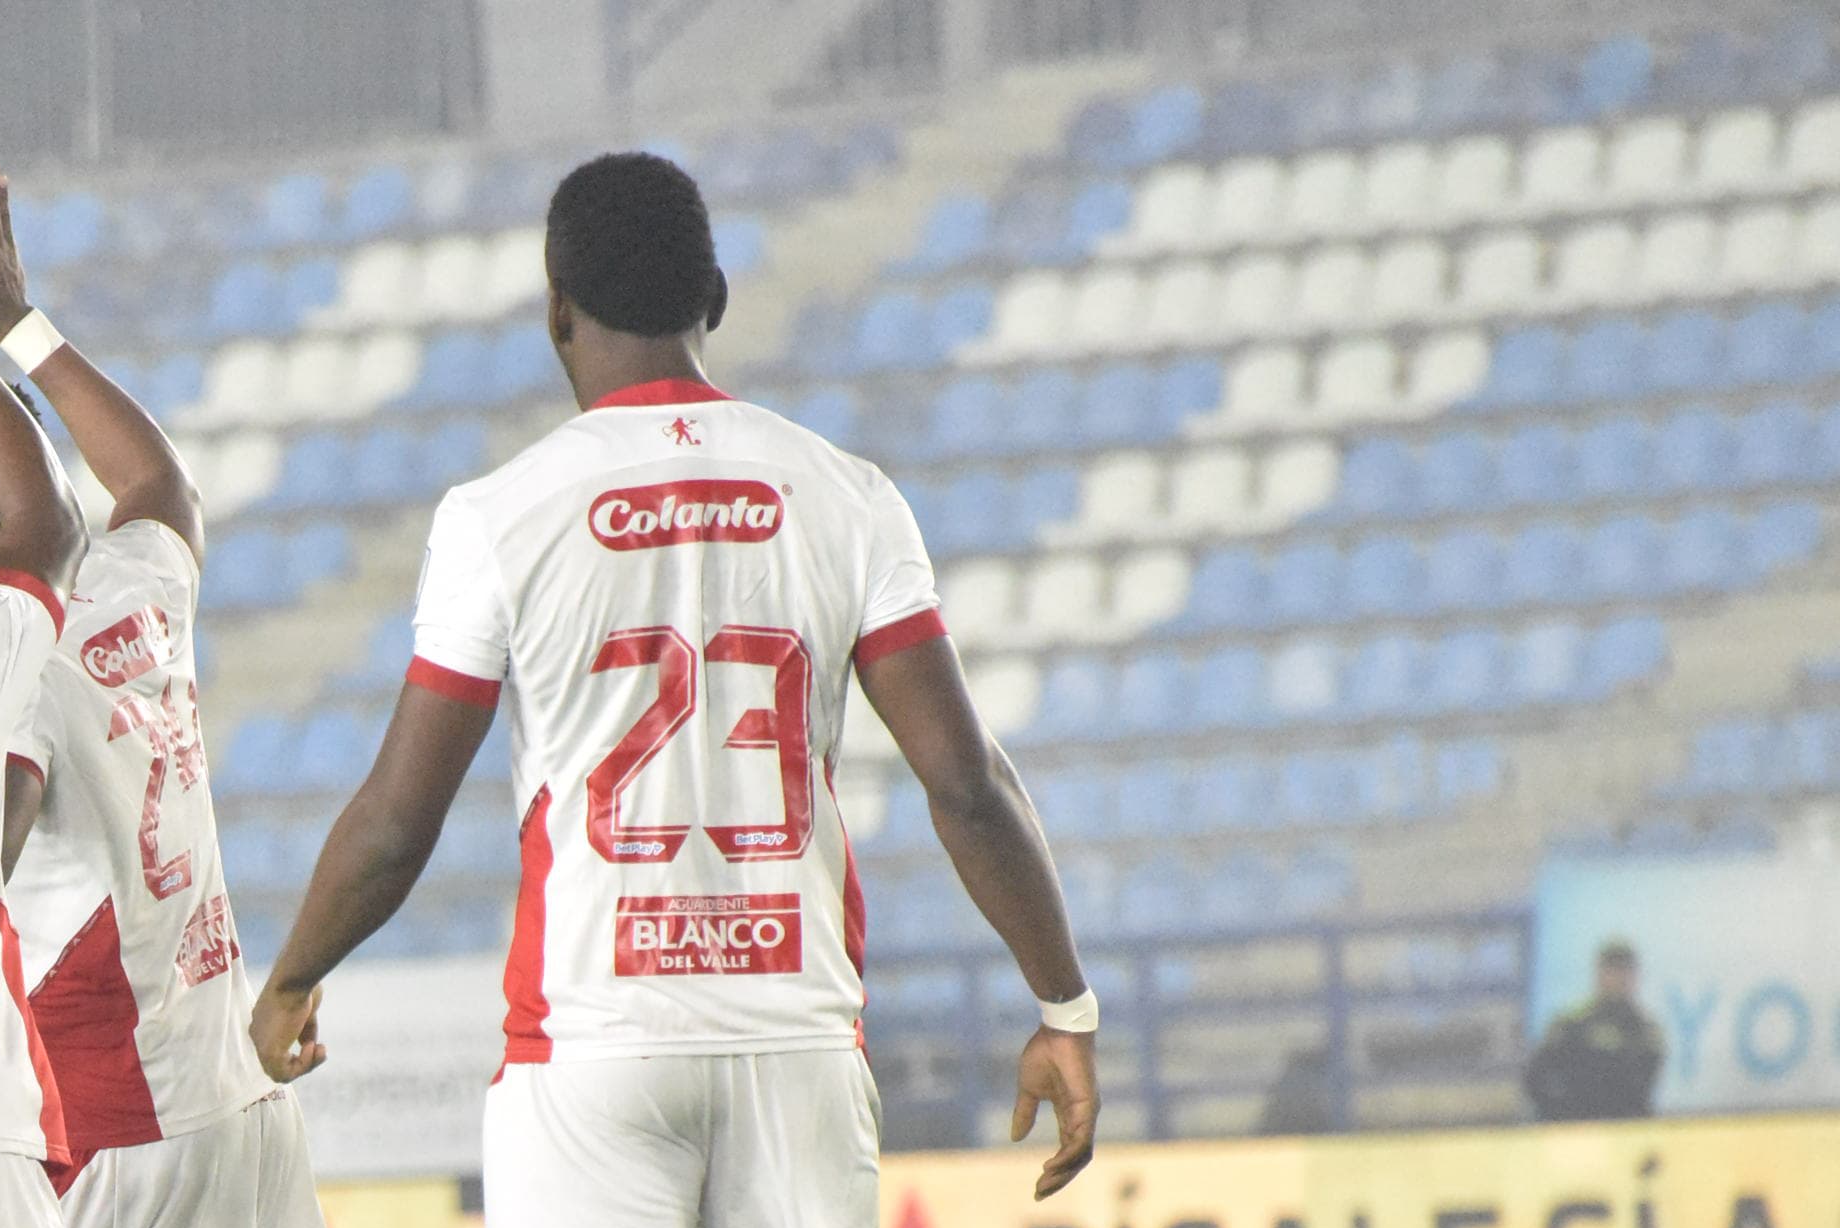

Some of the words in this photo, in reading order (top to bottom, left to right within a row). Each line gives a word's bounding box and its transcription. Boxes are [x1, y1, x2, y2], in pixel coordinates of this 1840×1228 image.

[593, 495, 777, 537] Colanta
[586, 624, 813, 864] 23
[668, 897, 750, 911] AGUARDENTE
[633, 918, 786, 950] BLANCO
[661, 955, 695, 969] DEL
[700, 954, 750, 968] VALLE
